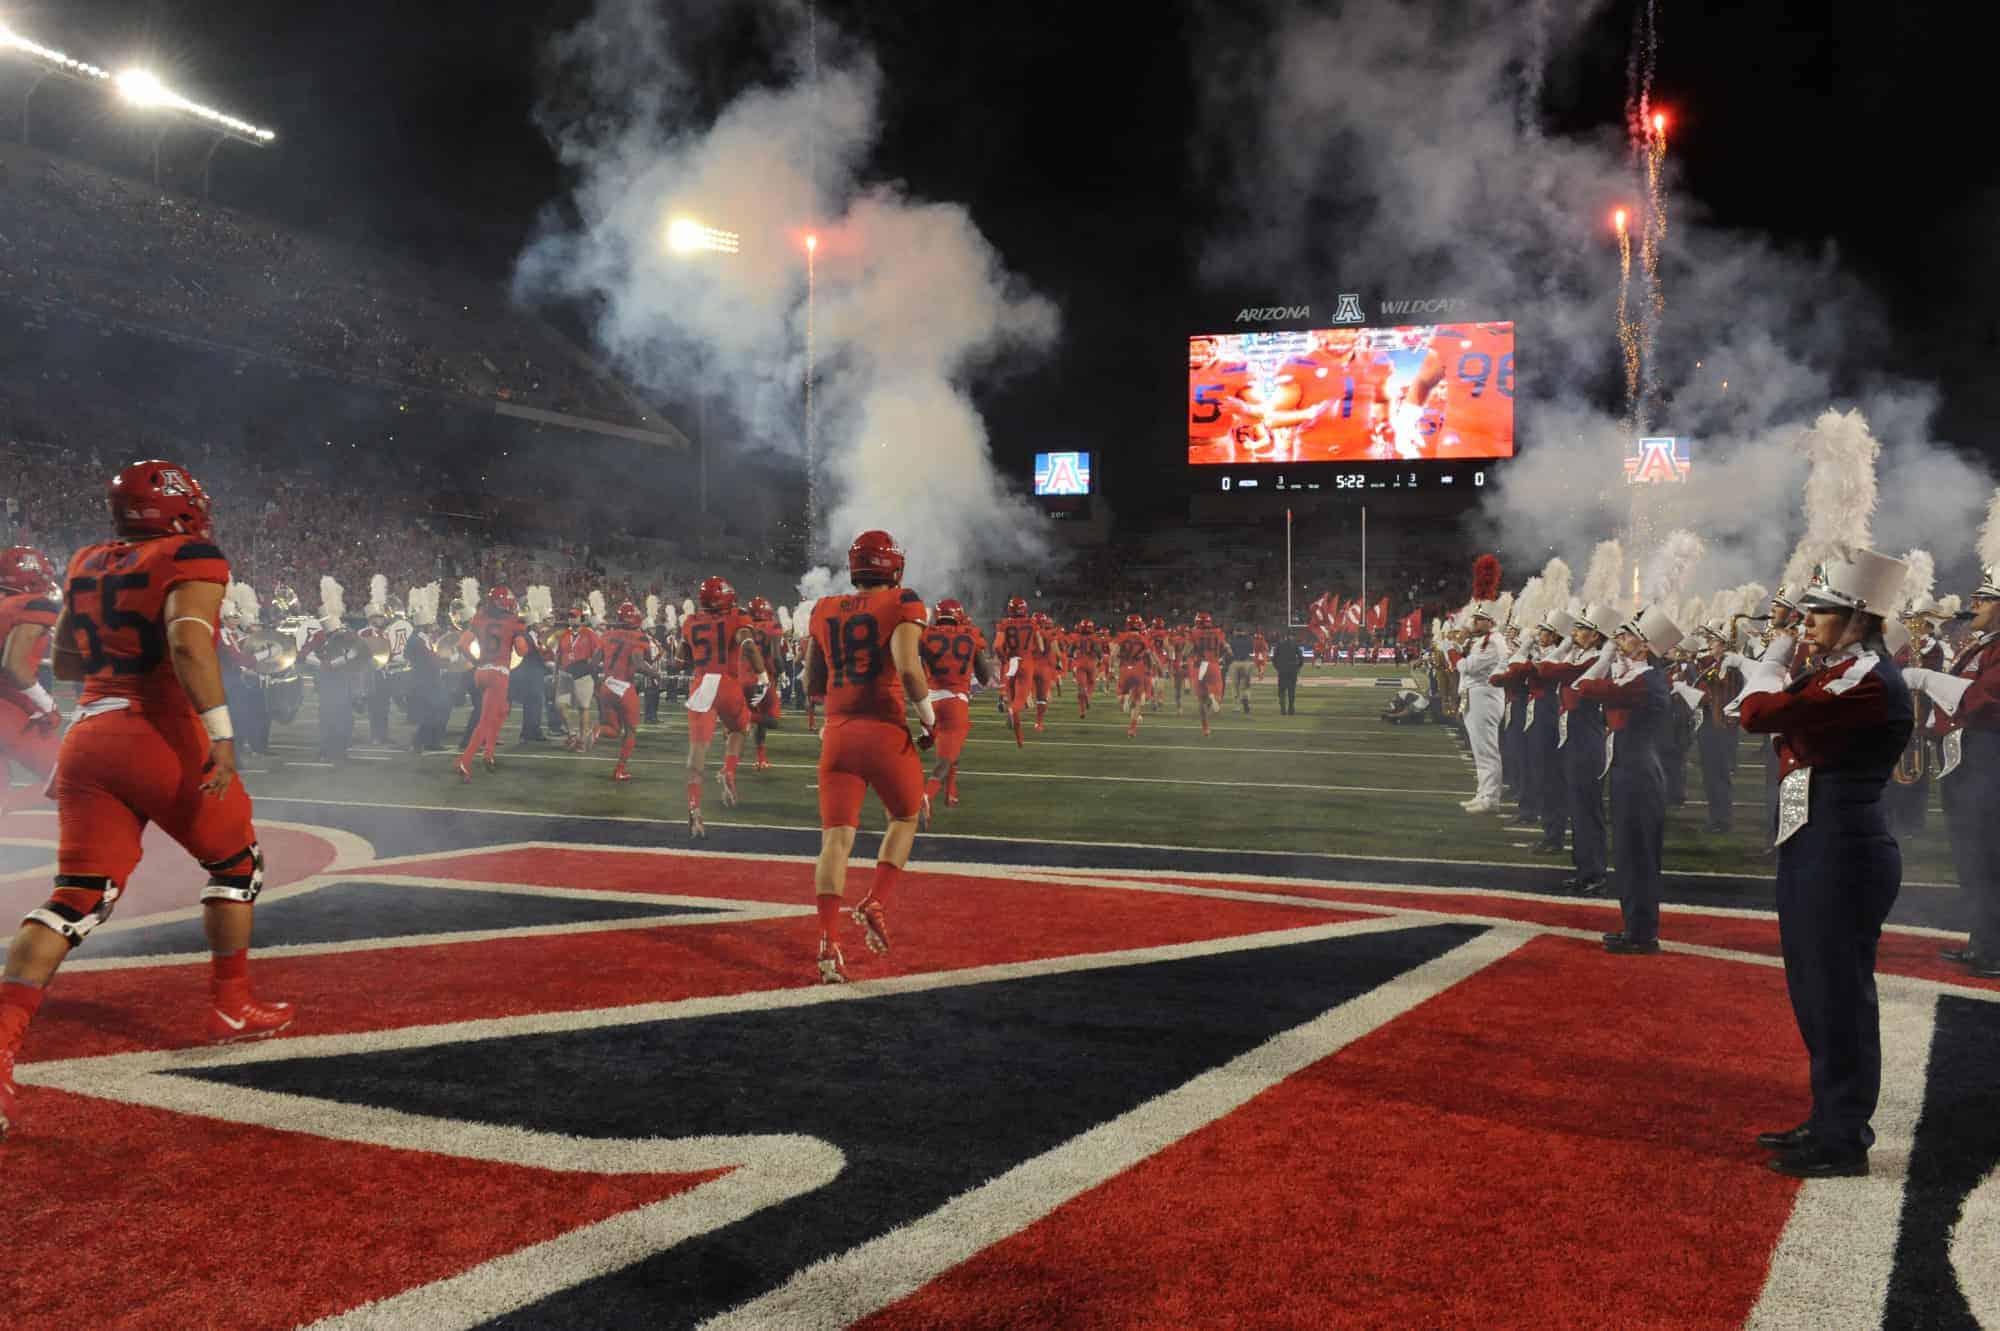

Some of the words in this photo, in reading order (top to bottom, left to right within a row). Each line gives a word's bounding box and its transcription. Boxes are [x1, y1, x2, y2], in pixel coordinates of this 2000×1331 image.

[1235, 304, 1311, 323] ARIZONA
[1381, 298, 1463, 314] WILDCAT
[1332, 293, 1366, 324] A
[1192, 384, 1225, 423] 5
[1040, 452, 1088, 495] A
[1633, 437, 1679, 482] A
[160, 469, 193, 497] A
[1221, 477, 1231, 490] 0
[1336, 475, 1366, 489] 5:22
[1474, 472, 1485, 486] 0
[69, 573, 163, 675] 55
[608, 638, 625, 670] 7
[690, 621, 727, 666] 51
[826, 612, 884, 689] 18
[926, 634, 974, 675] 29
[1006, 625, 1034, 656] 87
